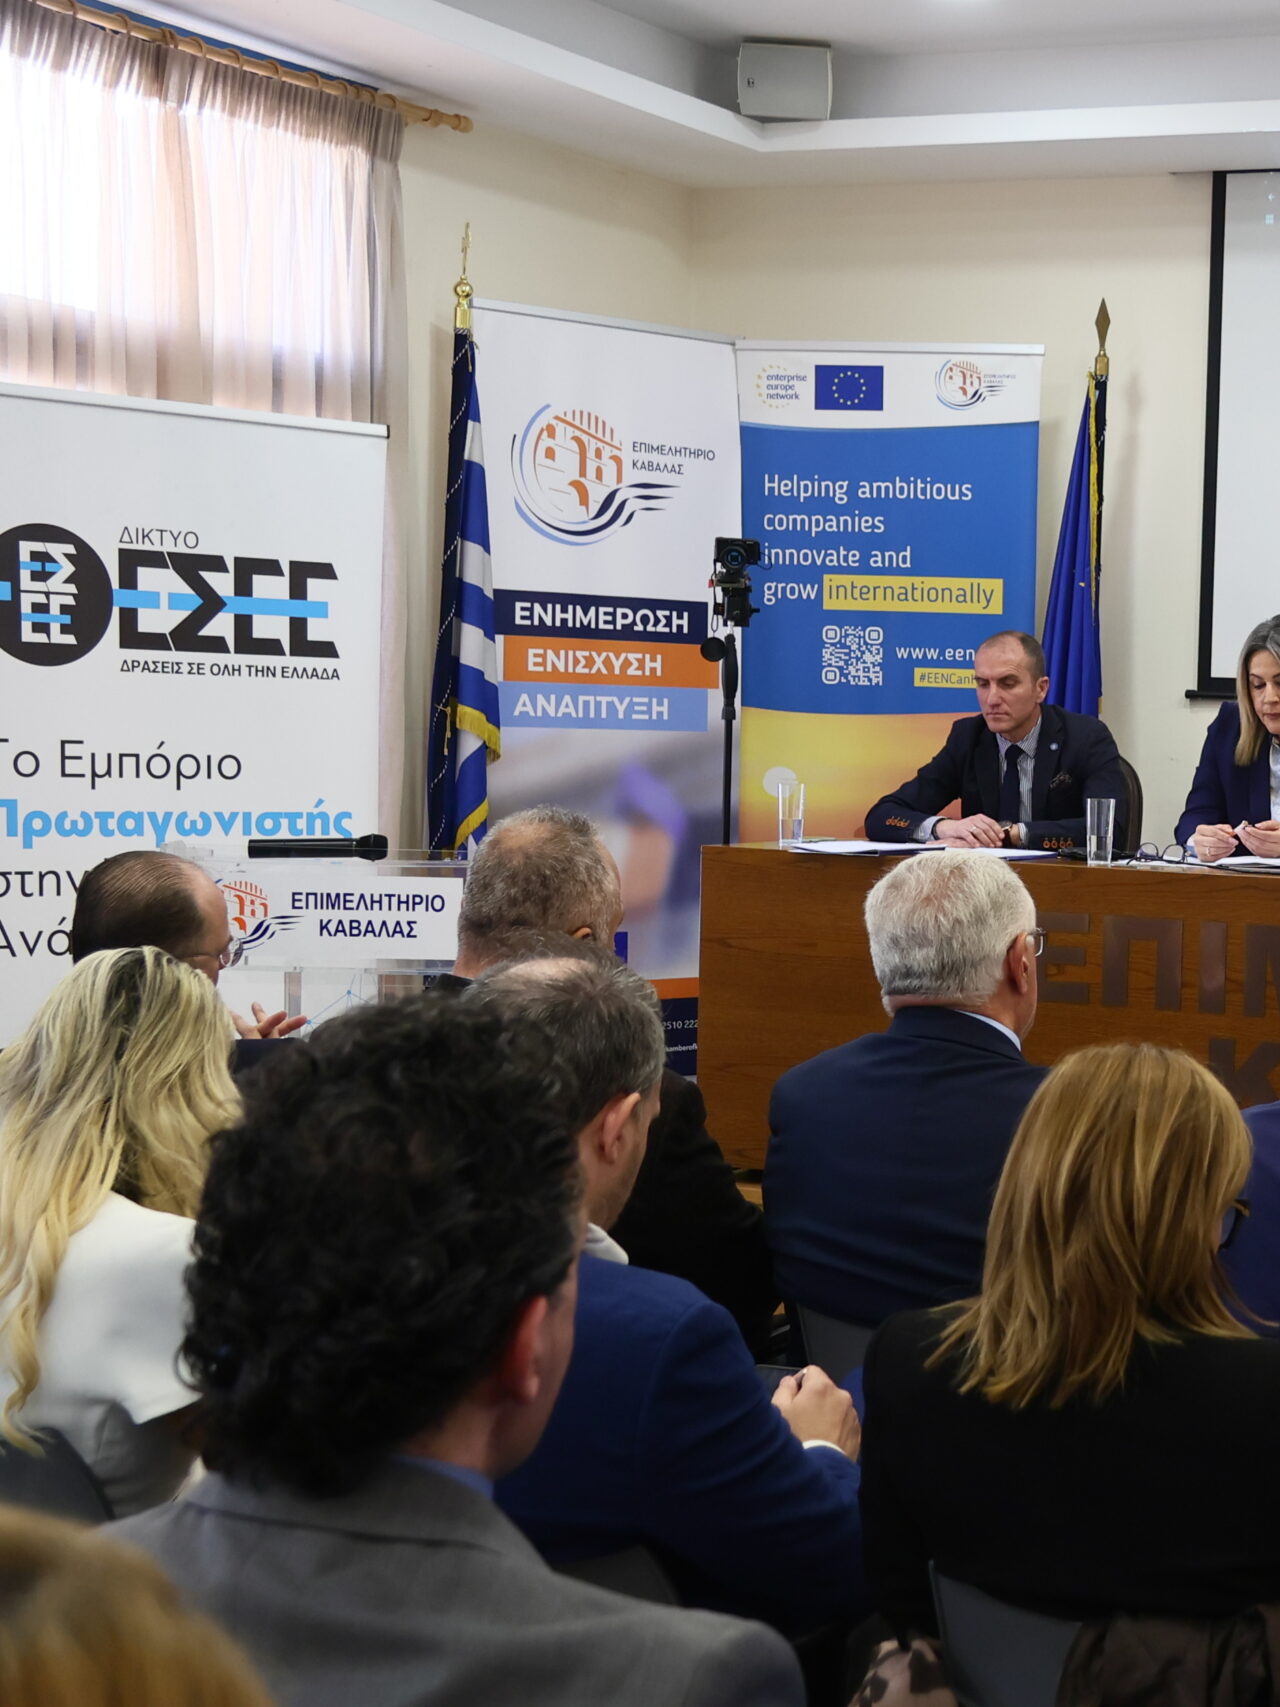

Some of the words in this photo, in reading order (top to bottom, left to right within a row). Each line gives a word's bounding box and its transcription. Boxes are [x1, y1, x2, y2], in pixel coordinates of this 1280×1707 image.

[767, 373, 807, 383] enterprise
[767, 384, 795, 392] europe
[767, 391, 800, 400] network
[632, 441, 716, 461] ΕΠΙΜΕΛΗΤΗΡΙΟ
[632, 459, 684, 475] ΚΑΒΑΛΑΣ
[763, 474, 849, 505] Helping
[857, 476, 972, 501] ambitious
[763, 510, 885, 537] companies
[118, 526, 200, 549] ΔΙΚΤΥΟ
[763, 543, 860, 566] innovate
[869, 546, 912, 568] and
[763, 580, 818, 605] grow
[828, 578, 994, 610] internationally
[514, 601, 689, 634] ΕΝΗΜΕΡΩΣΗ
[120, 659, 184, 676] ΔΡΑΣΕΙΣ
[187, 661, 206, 675] ΣΕ
[209, 662, 241, 677] ΟΛΗ
[245, 664, 277, 679] ΤΗΝ
[281, 665, 341, 681] ΕΛΛΑΔΑ
[527, 648, 663, 677] ΕΝΙΣΧΥΣΗ
[513, 693, 669, 721] ΑΝΑΠΤΥΞΗ
[59, 739, 242, 791] Εμπόριο
[291, 892, 446, 912] ΕΠΙΜΕΛΗΤΗΡΙΟ
[319, 919, 418, 938] ΚΑΒΑΛΑΣ
